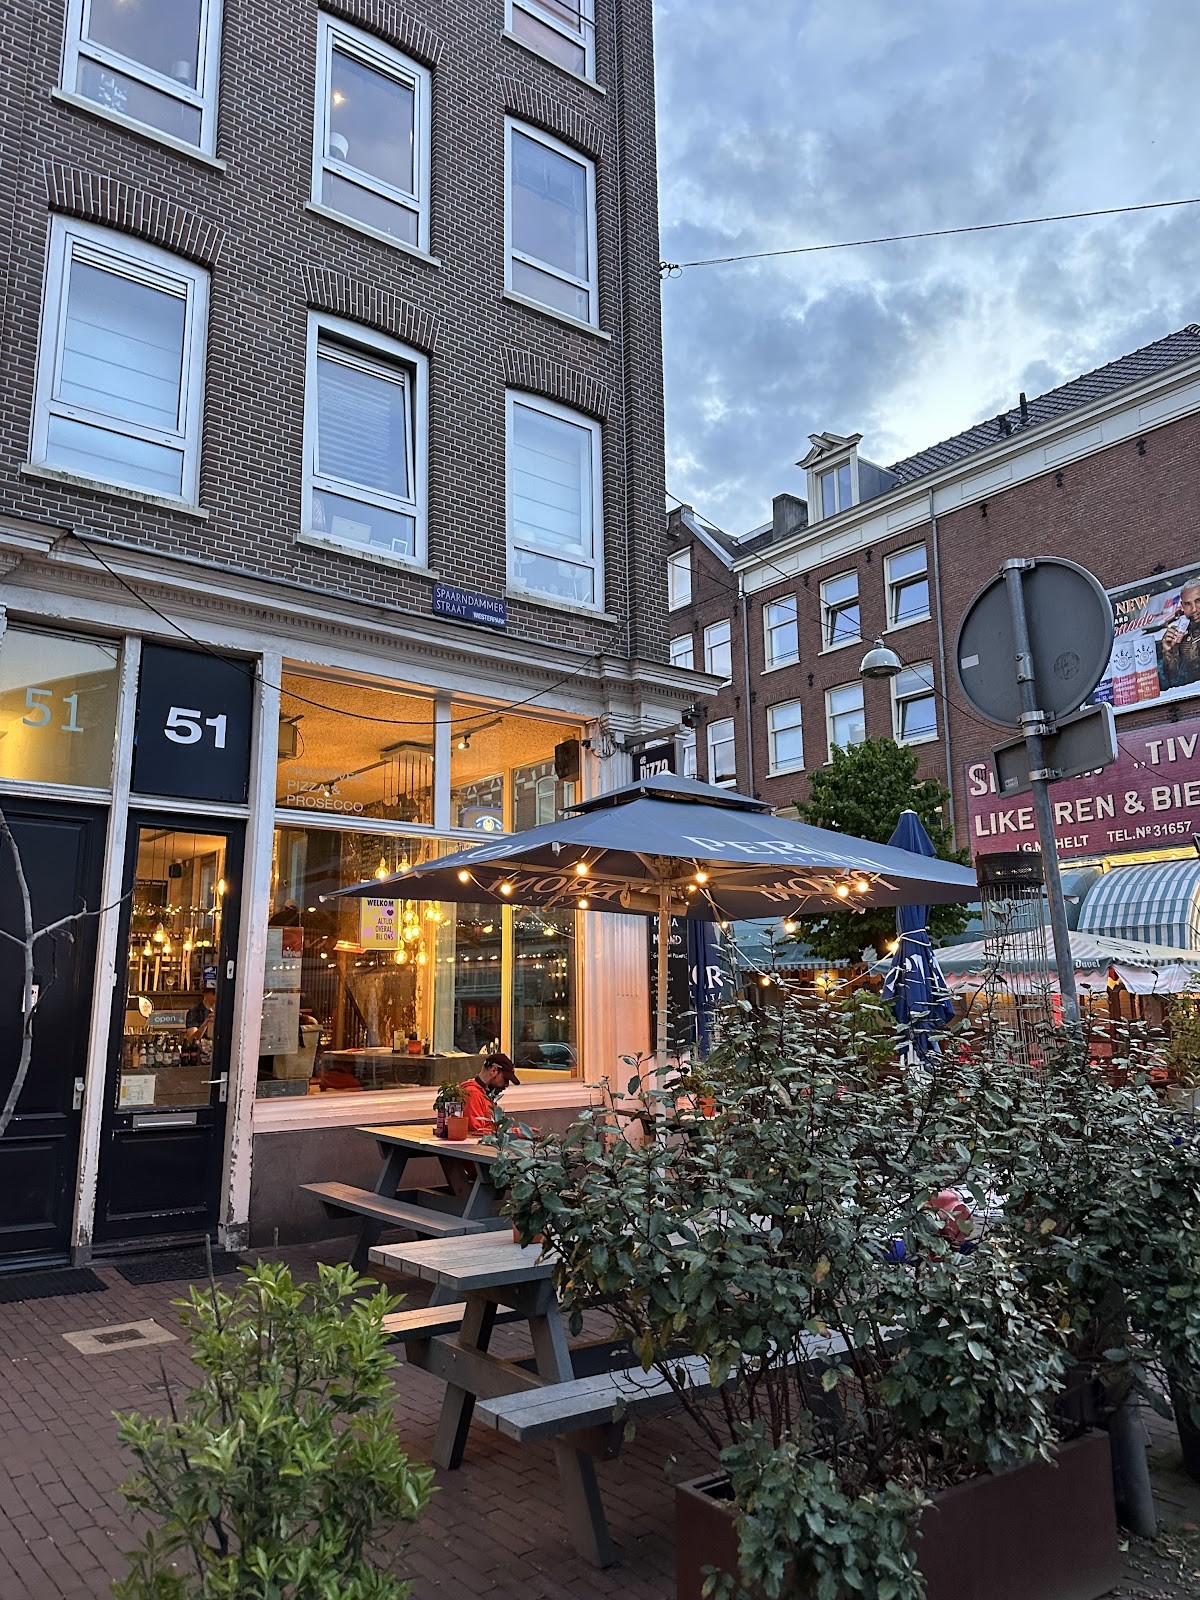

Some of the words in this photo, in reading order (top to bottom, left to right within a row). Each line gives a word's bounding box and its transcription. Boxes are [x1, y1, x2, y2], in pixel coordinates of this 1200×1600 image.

[436, 587, 504, 613] SPAARNDAMMER
[436, 600, 466, 616] STRAAT
[1115, 594, 1150, 616] NEW
[472, 612, 505, 625] WESTERPARK
[22, 687, 84, 733] 51
[163, 706, 228, 749] 51
[287, 779, 326, 794] PIZZA
[331, 784, 341, 795] &
[286, 794, 364, 813] PROSECCO
[974, 794, 1116, 838] LIKEREN
[1123, 790, 1146, 815] &
[1153, 820, 1192, 837] 31657
[367, 899, 394, 907] WELKOM
[1075, 958, 1101, 969] Duvel
[154, 1014, 176, 1023] open
